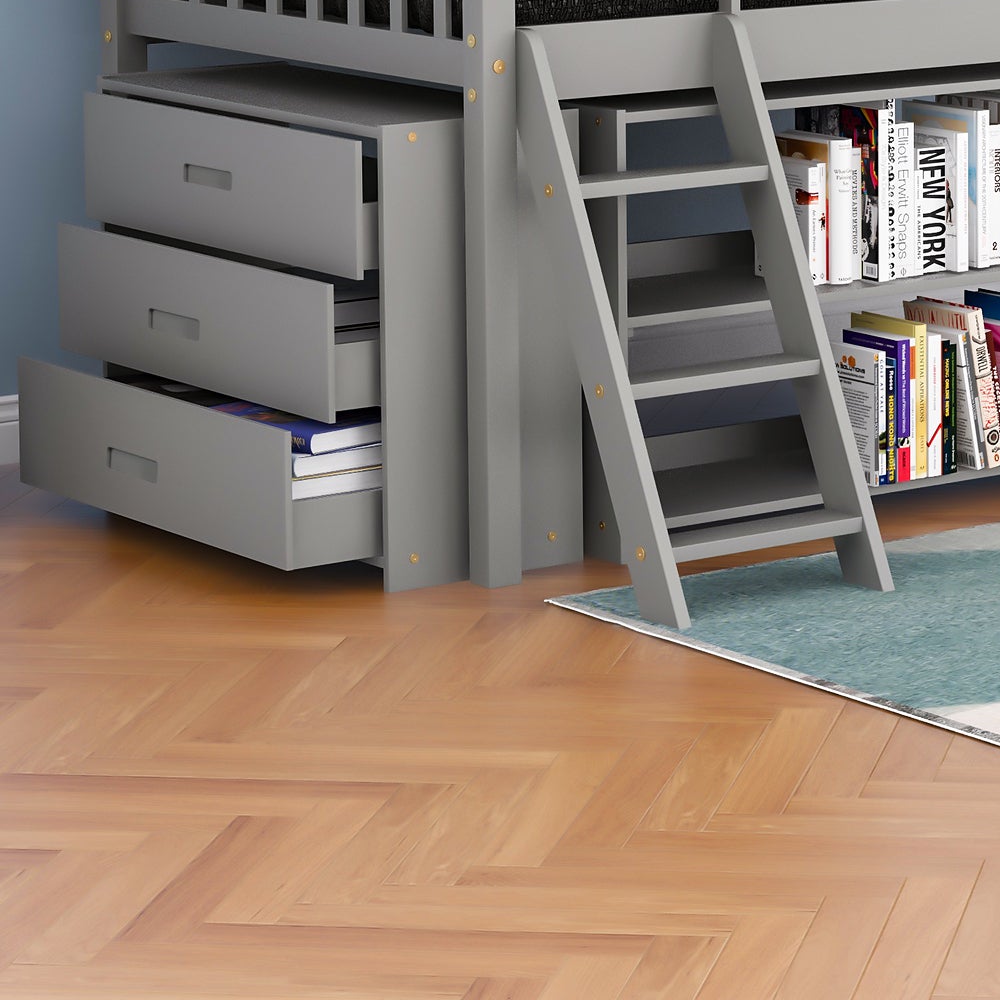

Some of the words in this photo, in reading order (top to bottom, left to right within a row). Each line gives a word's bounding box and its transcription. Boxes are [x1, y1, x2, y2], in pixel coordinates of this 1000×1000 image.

[897, 127, 910, 165] Elliott
[897, 169, 910, 211] Erwitt
[919, 148, 946, 199] NEW
[896, 213, 910, 260] Snaps
[922, 207, 947, 269] YORK
[992, 241, 998, 251] 2
[975, 346, 988, 373] ORWELL
[880, 382, 884, 392] AT
[887, 448, 896, 481] NIGHTS
